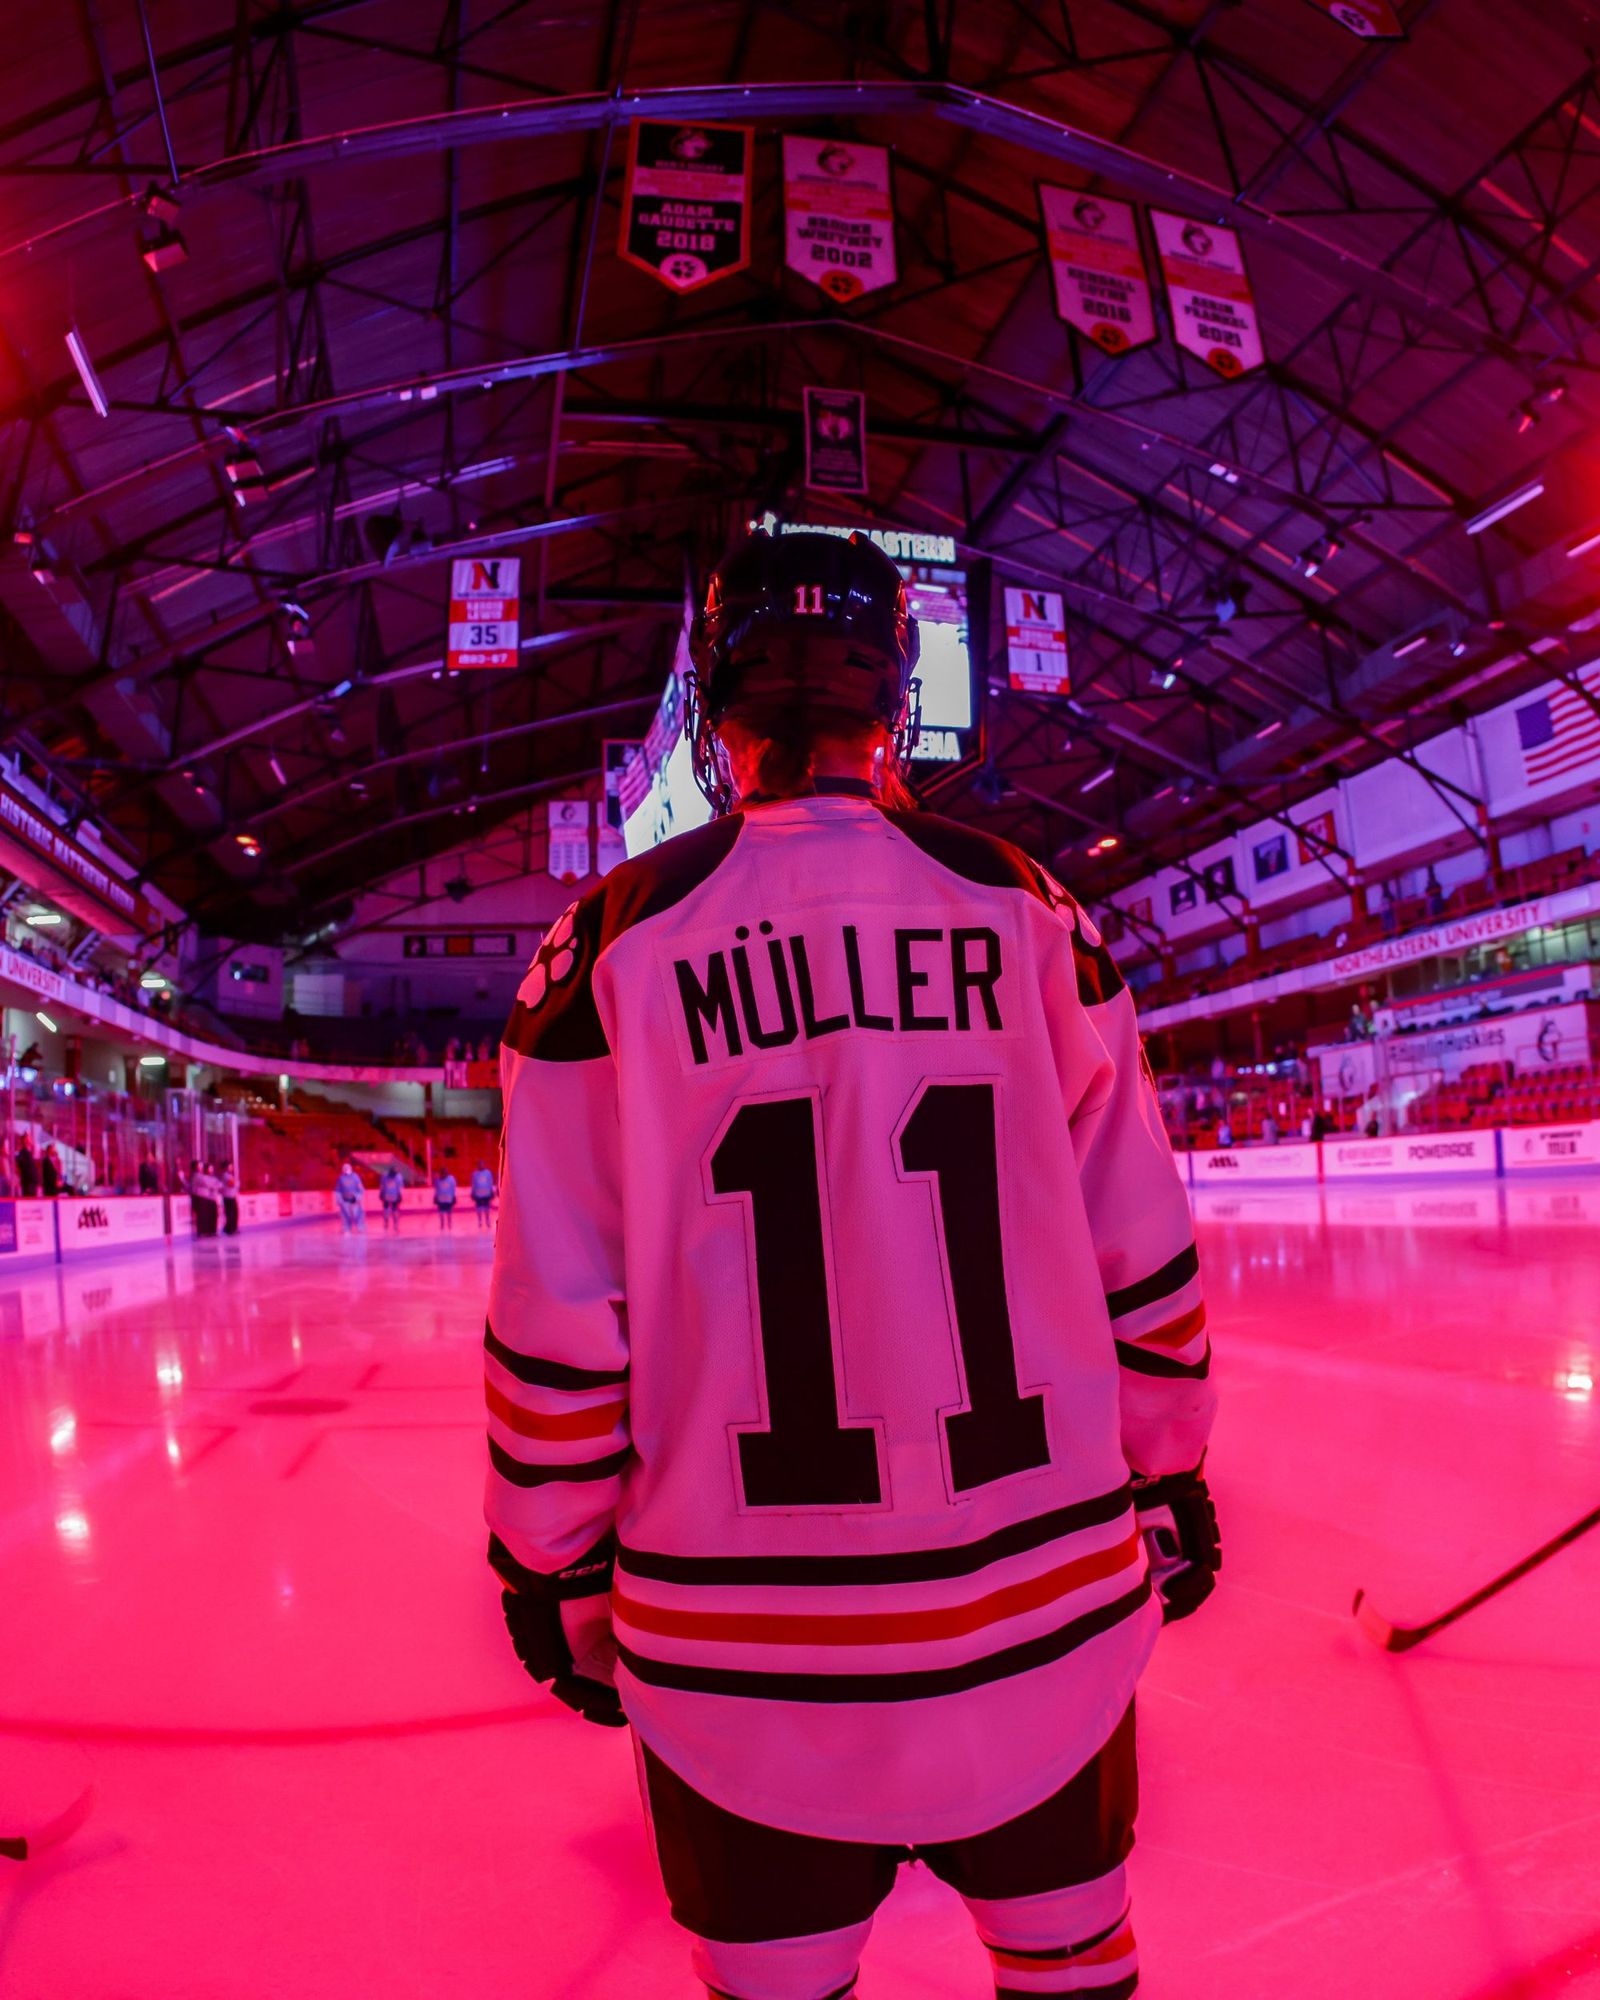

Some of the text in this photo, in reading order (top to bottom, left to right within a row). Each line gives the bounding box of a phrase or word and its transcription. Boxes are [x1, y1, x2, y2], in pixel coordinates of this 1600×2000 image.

[661, 203, 714, 218] ADAM
[656, 230, 715, 251] 2018
[810, 243, 872, 269] 2002
[1197, 323, 1243, 349] 2021
[472, 562, 501, 590] N
[794, 585, 825, 614] 11
[1022, 593, 1047, 621] N
[470, 624, 498, 645] 35
[1035, 653, 1043, 672] 1
[1333, 904, 1540, 976] NORTHEASTERN UNIVERSITY
[8, 955, 61, 996] UNIVERSITY
[673, 920, 1003, 1064] MÜLLER
[1407, 1142, 1476, 1160] POWERADE
[709, 1083, 1053, 1506] 11
